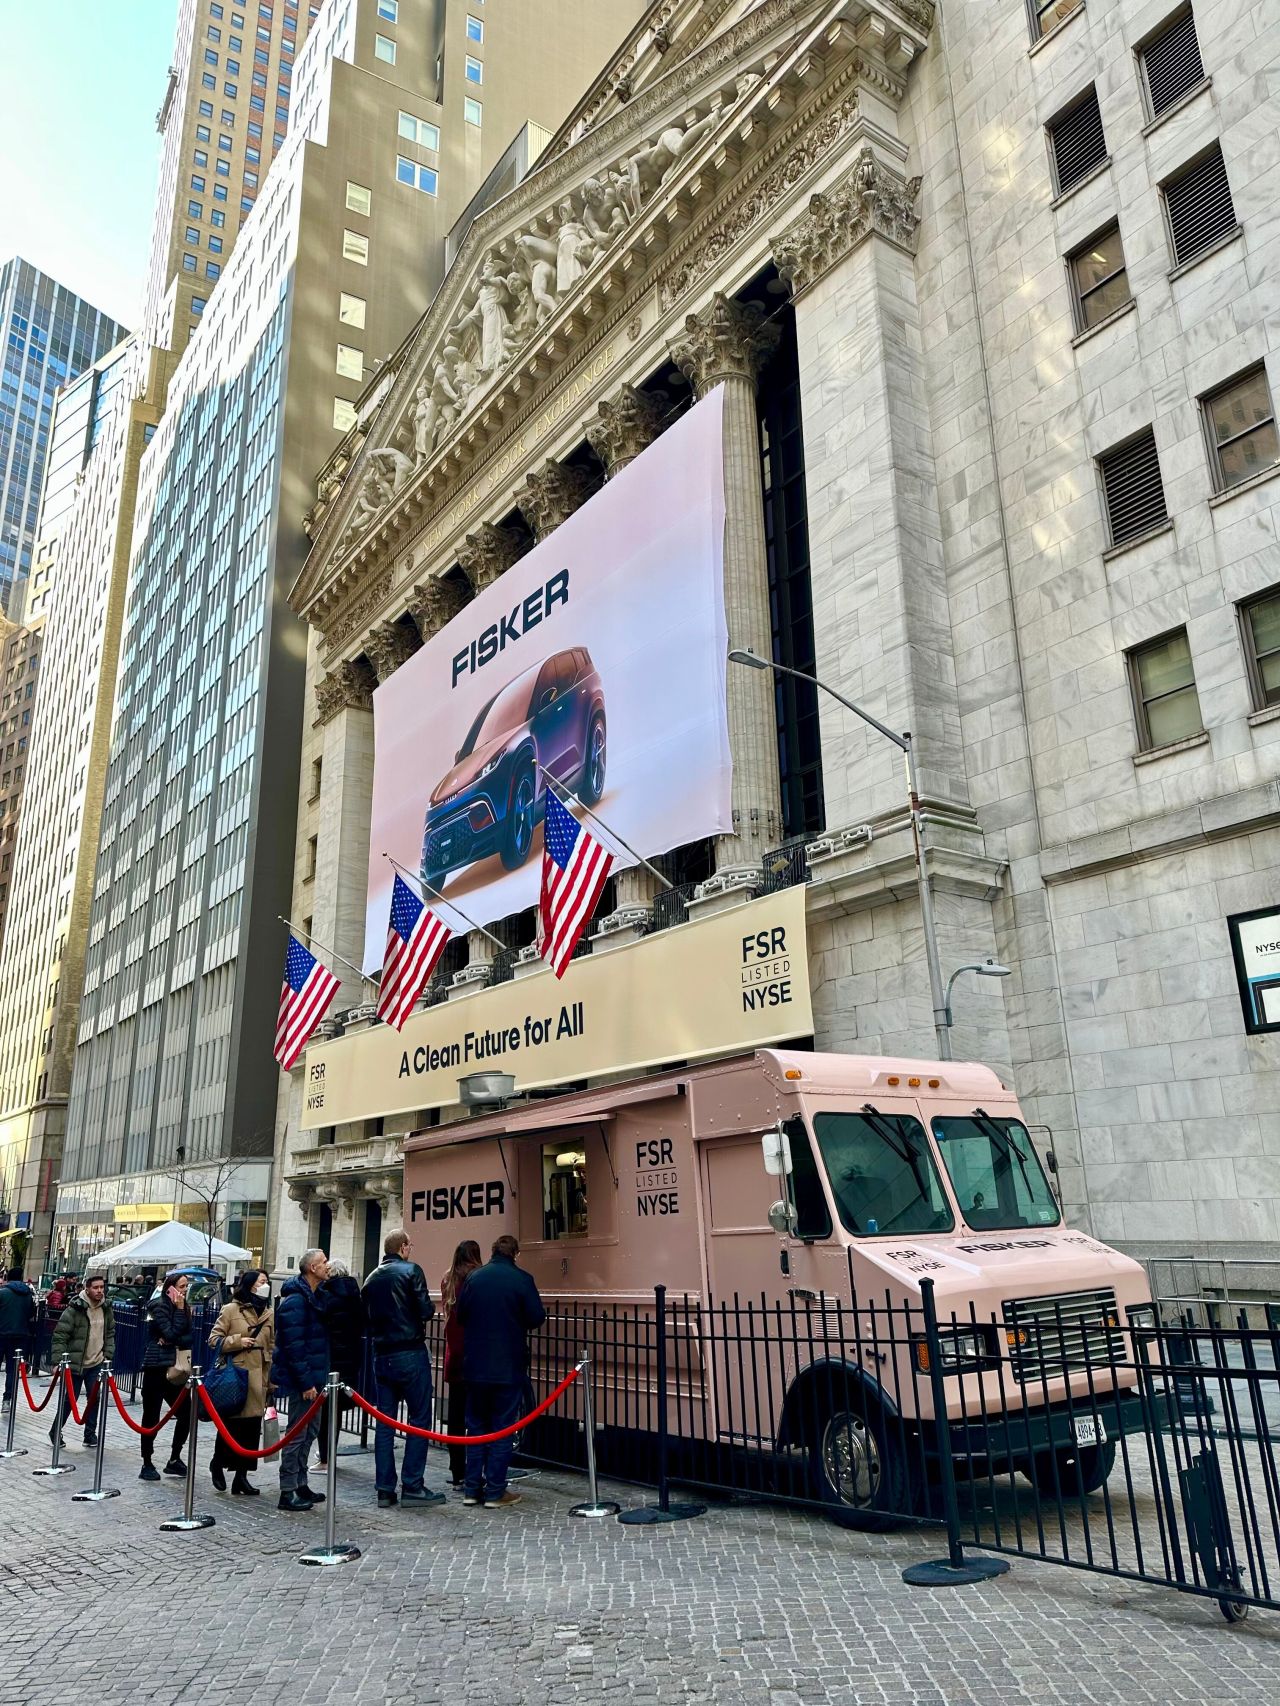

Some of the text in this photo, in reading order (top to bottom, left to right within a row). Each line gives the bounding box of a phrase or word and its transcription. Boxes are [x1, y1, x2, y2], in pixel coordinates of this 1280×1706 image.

[421, 345, 616, 552] NEW YORK STOCK EXCHANGE
[451, 568, 570, 689] FISKER
[742, 926, 786, 963] FSR
[742, 960, 791, 984] LISTED
[743, 982, 792, 1012] NYSE
[399, 1002, 584, 1078] A Clean Future for All
[310, 1063, 326, 1081] FSR
[307, 1095, 324, 1110] NYSE
[636, 1139, 674, 1167] FSR
[636, 1173, 677, 1188] LISTED
[411, 1181, 504, 1222] FISKER
[637, 1193, 679, 1217] NYSE
[886, 1250, 922, 1260] FSR
[957, 1240, 1057, 1254] FISKER
[908, 1261, 945, 1273] NYSE
